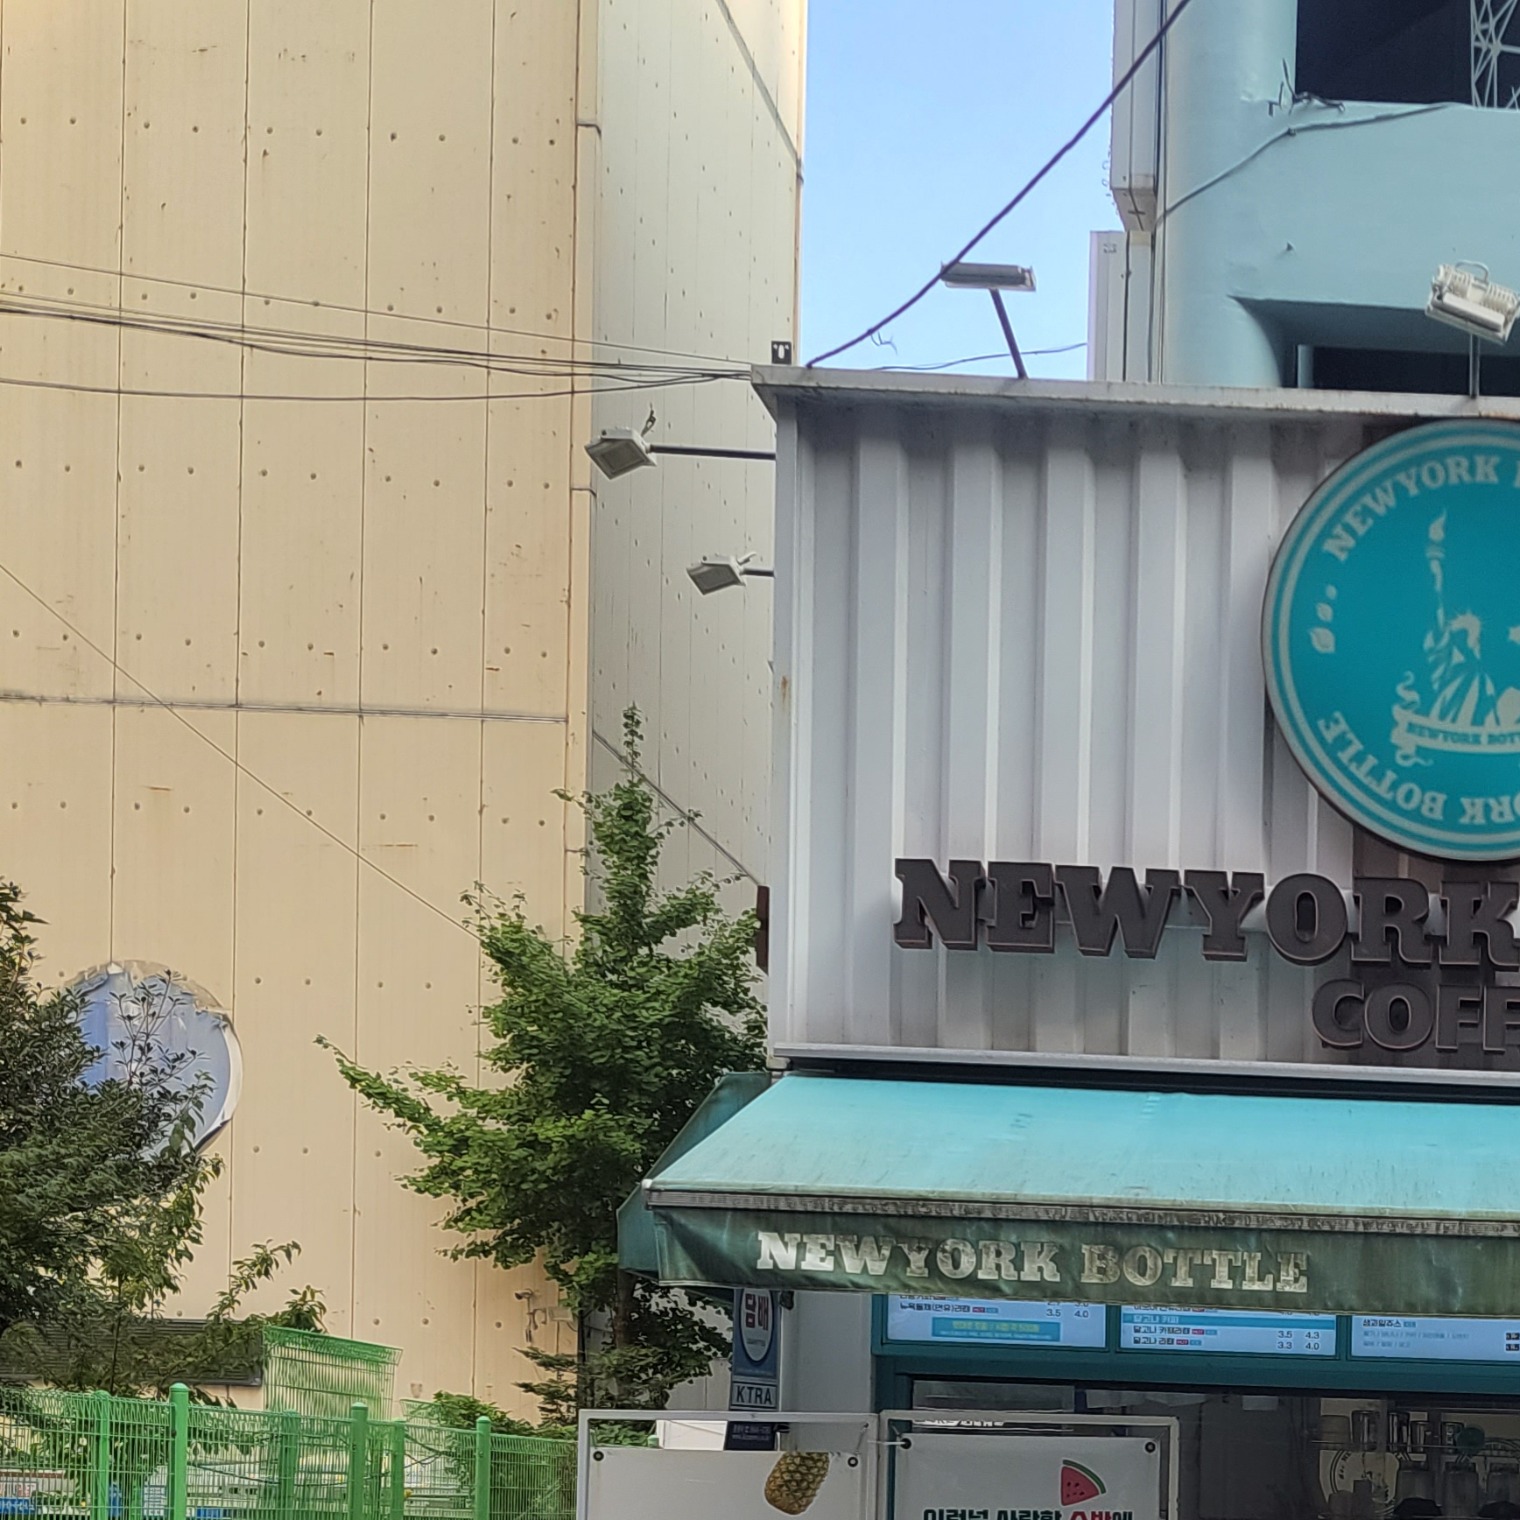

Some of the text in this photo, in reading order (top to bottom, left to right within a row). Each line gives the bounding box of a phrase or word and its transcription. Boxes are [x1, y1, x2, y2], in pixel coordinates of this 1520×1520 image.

[1323, 456, 1499, 563] NEWYORK
[1406, 723, 1481, 744] NEWYORK
[1317, 711, 1447, 822] BOTTLE
[895, 858, 1519, 972] NEWYORK
[755, 1231, 1309, 1293] NEWYORK BOTTLE
[1046, 1309, 1089, 1318] 3.5 4.0
[1277, 1330, 1292, 1338] 3.5
[1305, 1331, 1320, 1339] 4.3
[1277, 1341, 1292, 1349] 3.3
[1305, 1342, 1320, 1350] 4.0
[736, 1386, 773, 1405] KTRA
